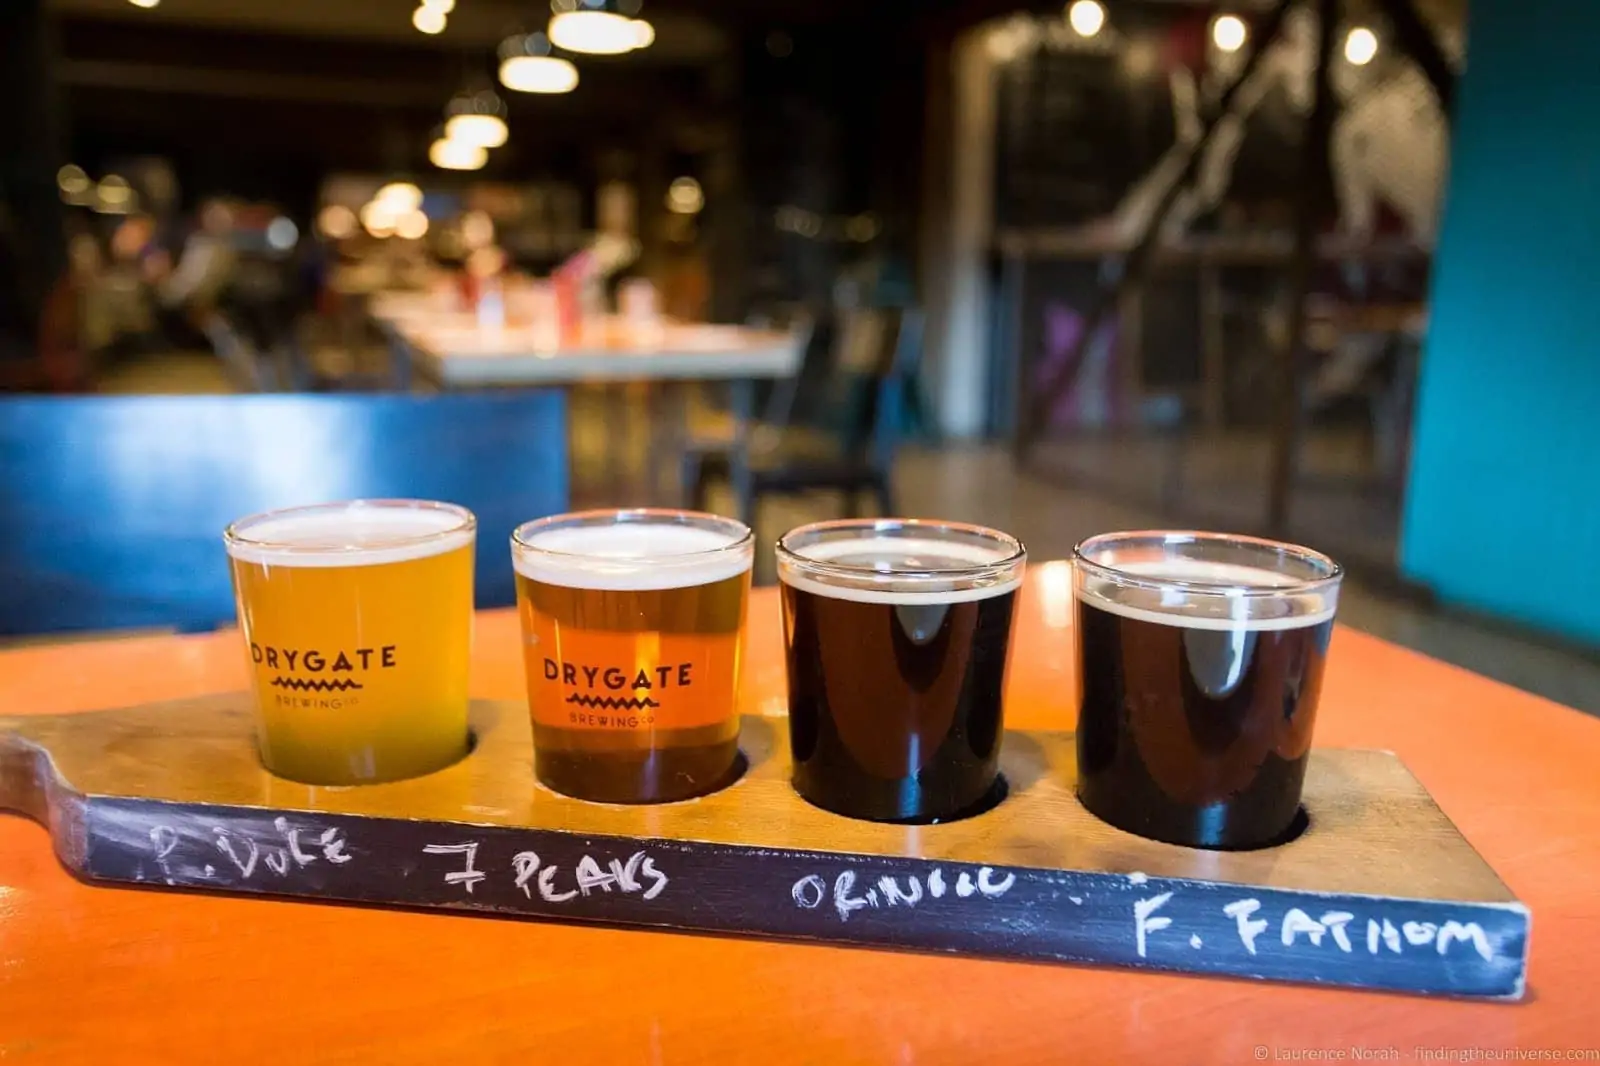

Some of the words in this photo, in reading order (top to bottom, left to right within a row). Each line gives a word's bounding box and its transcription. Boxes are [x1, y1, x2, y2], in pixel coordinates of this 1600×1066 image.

[250, 642, 396, 672] DRYGATE
[544, 657, 692, 690] DRYGATE
[569, 712, 639, 728] BREWING
[422, 842, 487, 893] 7
[511, 850, 669, 902] PEAKS
[1223, 898, 1493, 962] FATHOM
